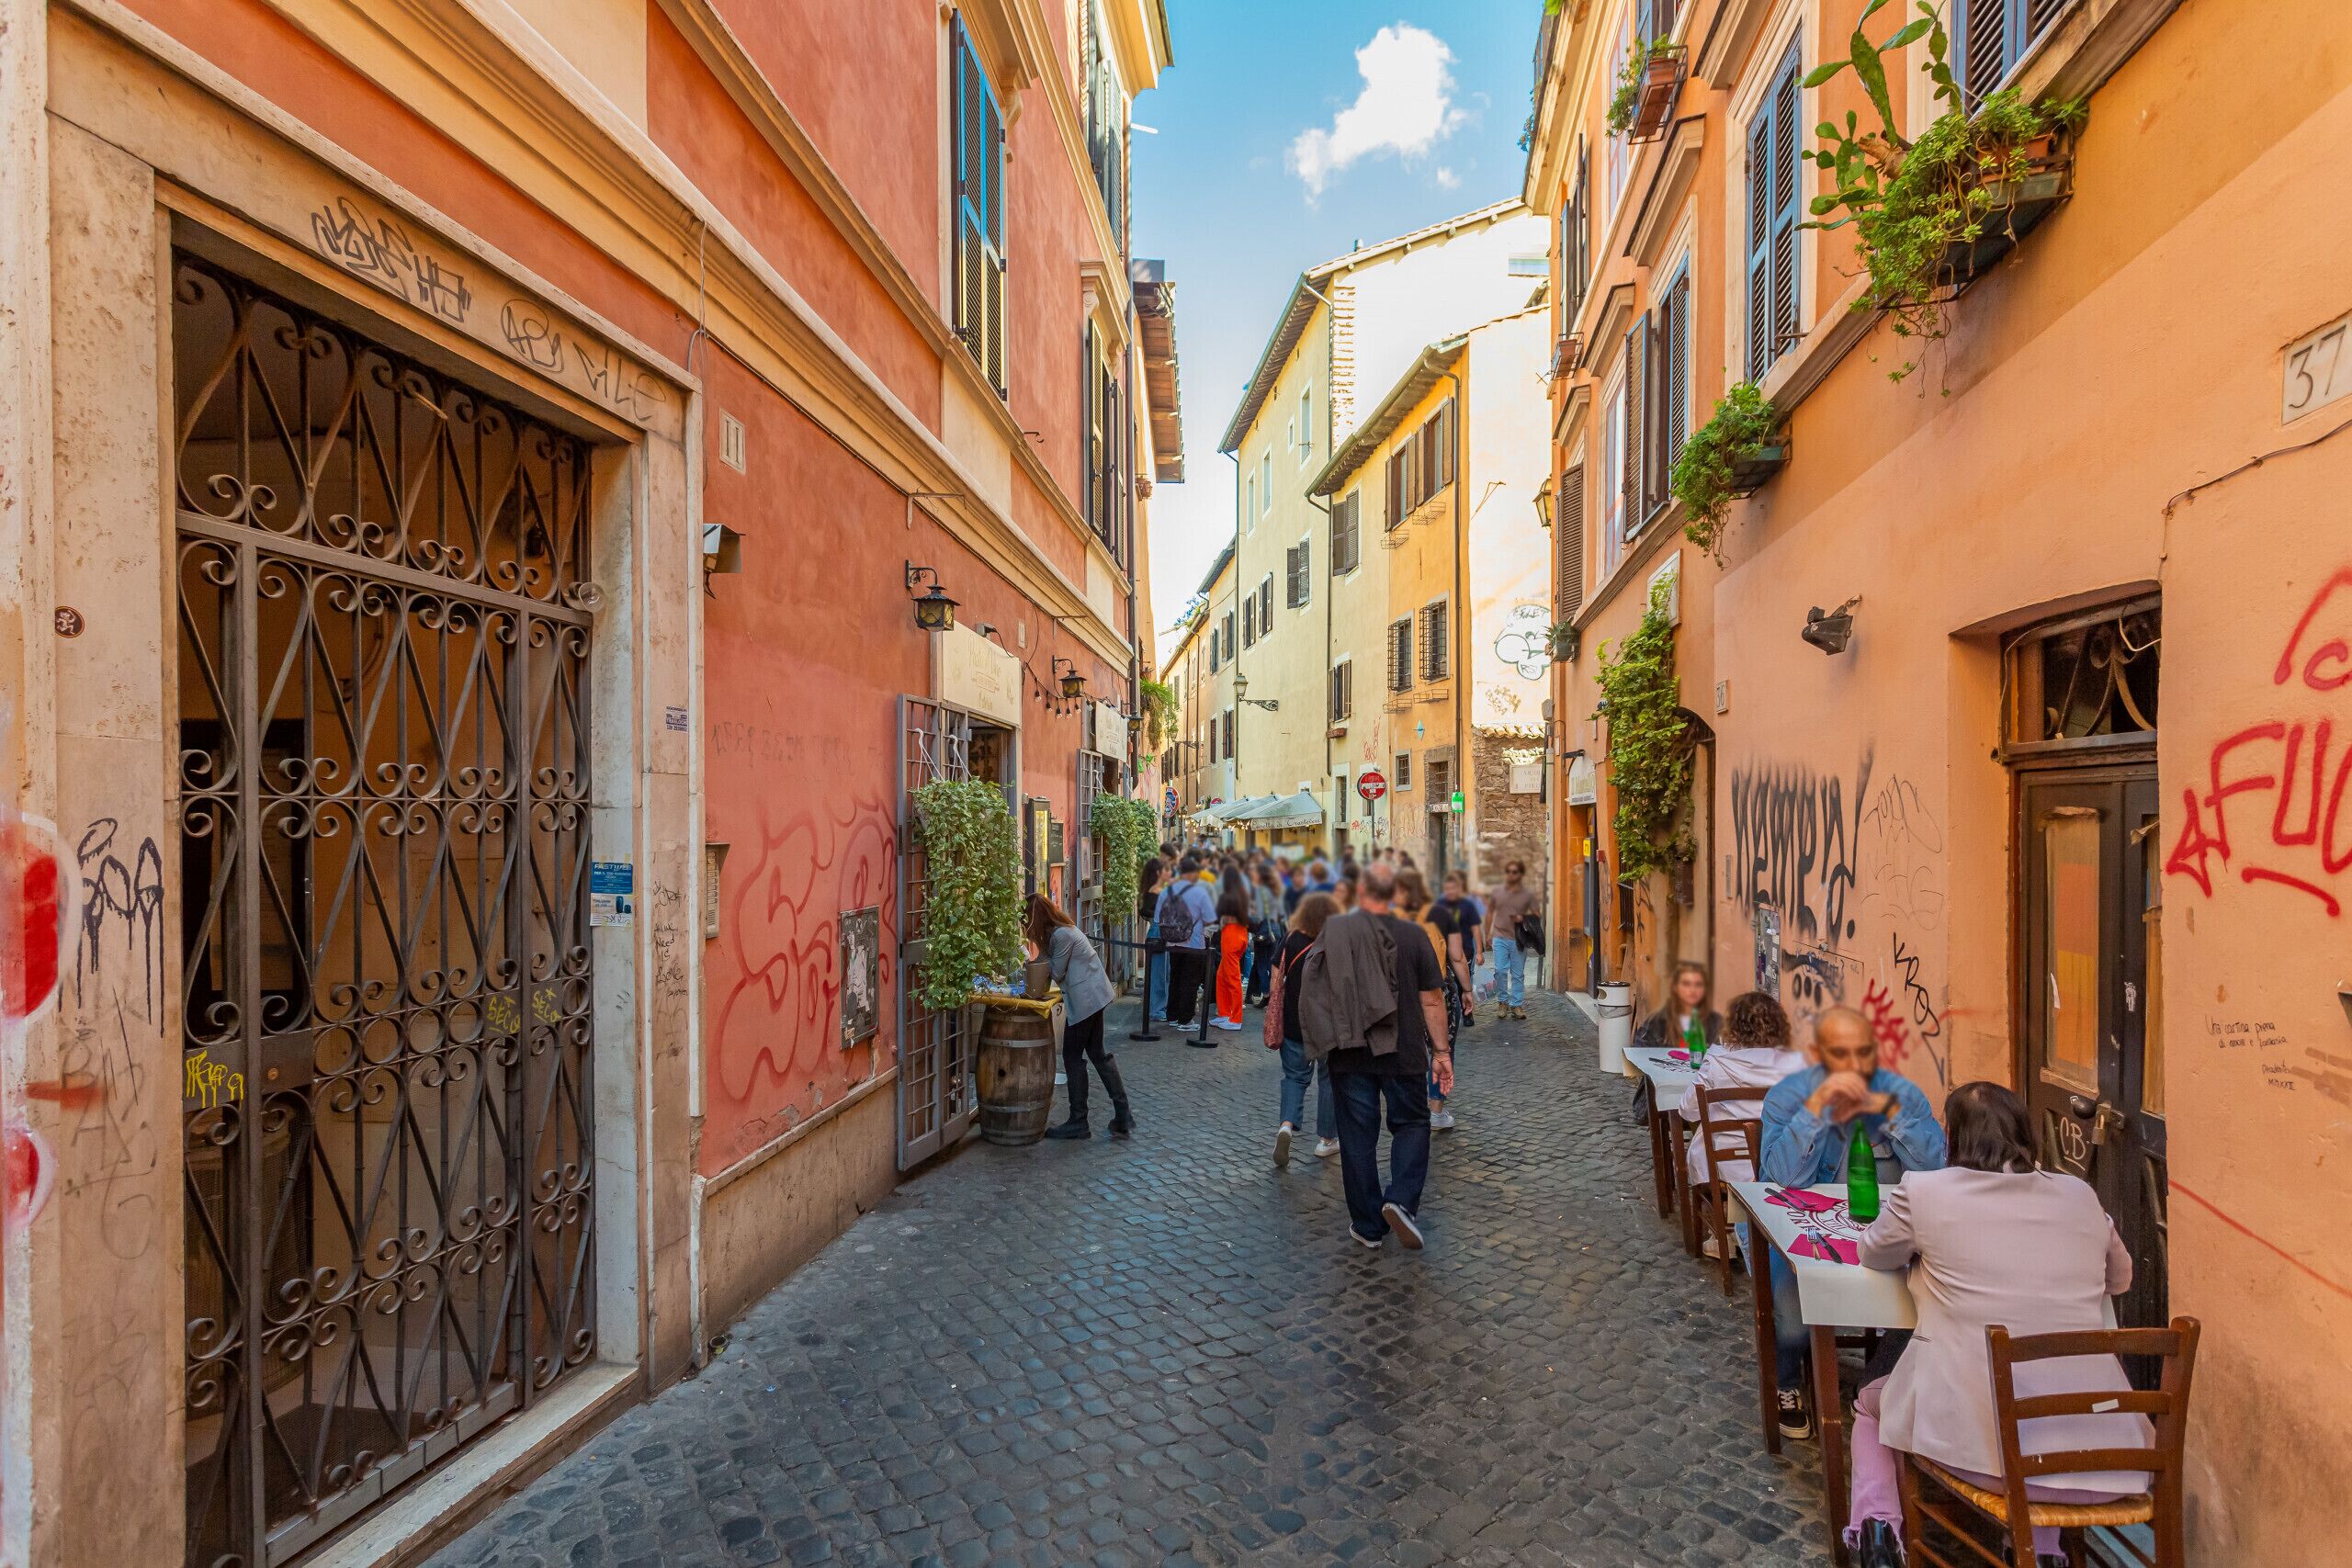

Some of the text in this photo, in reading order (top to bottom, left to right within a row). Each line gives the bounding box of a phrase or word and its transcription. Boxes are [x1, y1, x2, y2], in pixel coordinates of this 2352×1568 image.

[2289, 323, 2347, 410] 37
[1716, 684, 1724, 707] 36
[1286, 815, 1320, 827] Trastevere
